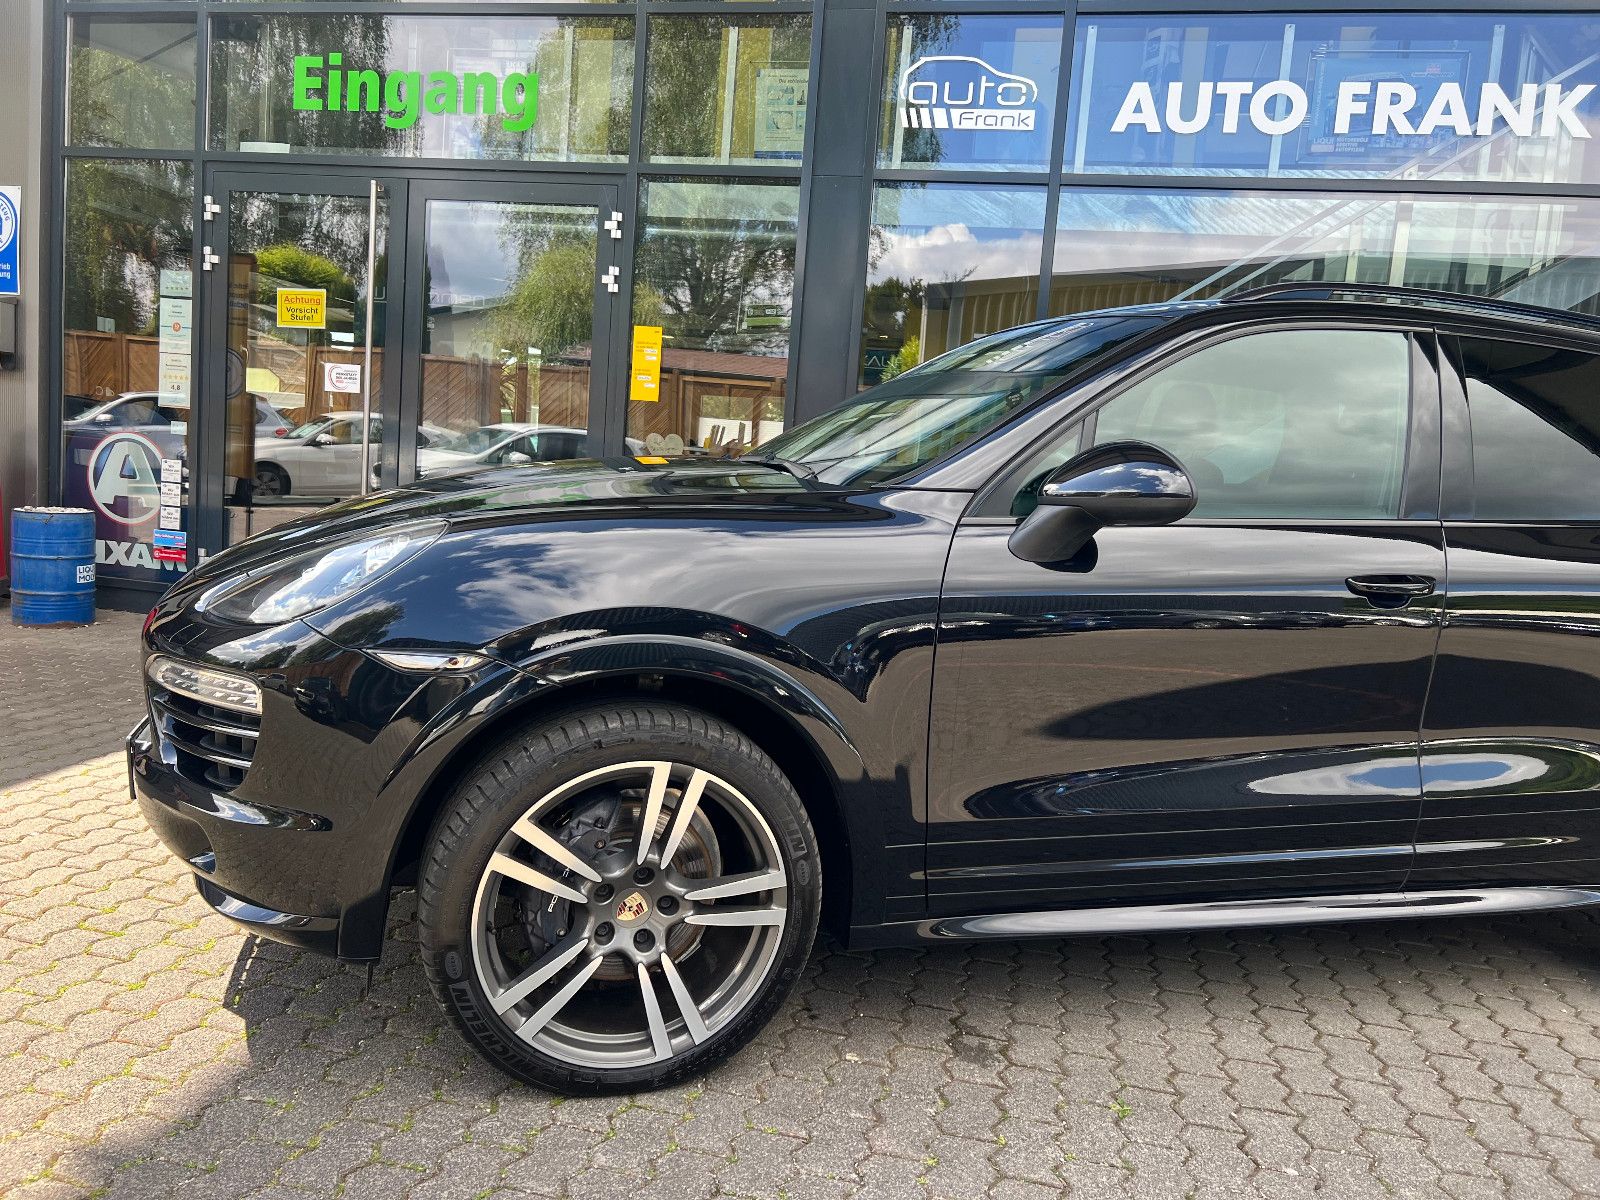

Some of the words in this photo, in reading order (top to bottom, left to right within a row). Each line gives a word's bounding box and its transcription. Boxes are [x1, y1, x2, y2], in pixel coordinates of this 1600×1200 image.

[293, 53, 540, 132] Eingang
[908, 76, 1027, 105] auto
[1110, 80, 1308, 135] AUTO
[1334, 82, 1598, 139] FRANK
[958, 112, 1031, 127] Frank
[284, 295, 321, 306] Achtung
[286, 306, 319, 314] Vorsicht
[290, 313, 314, 321] Stufe!
